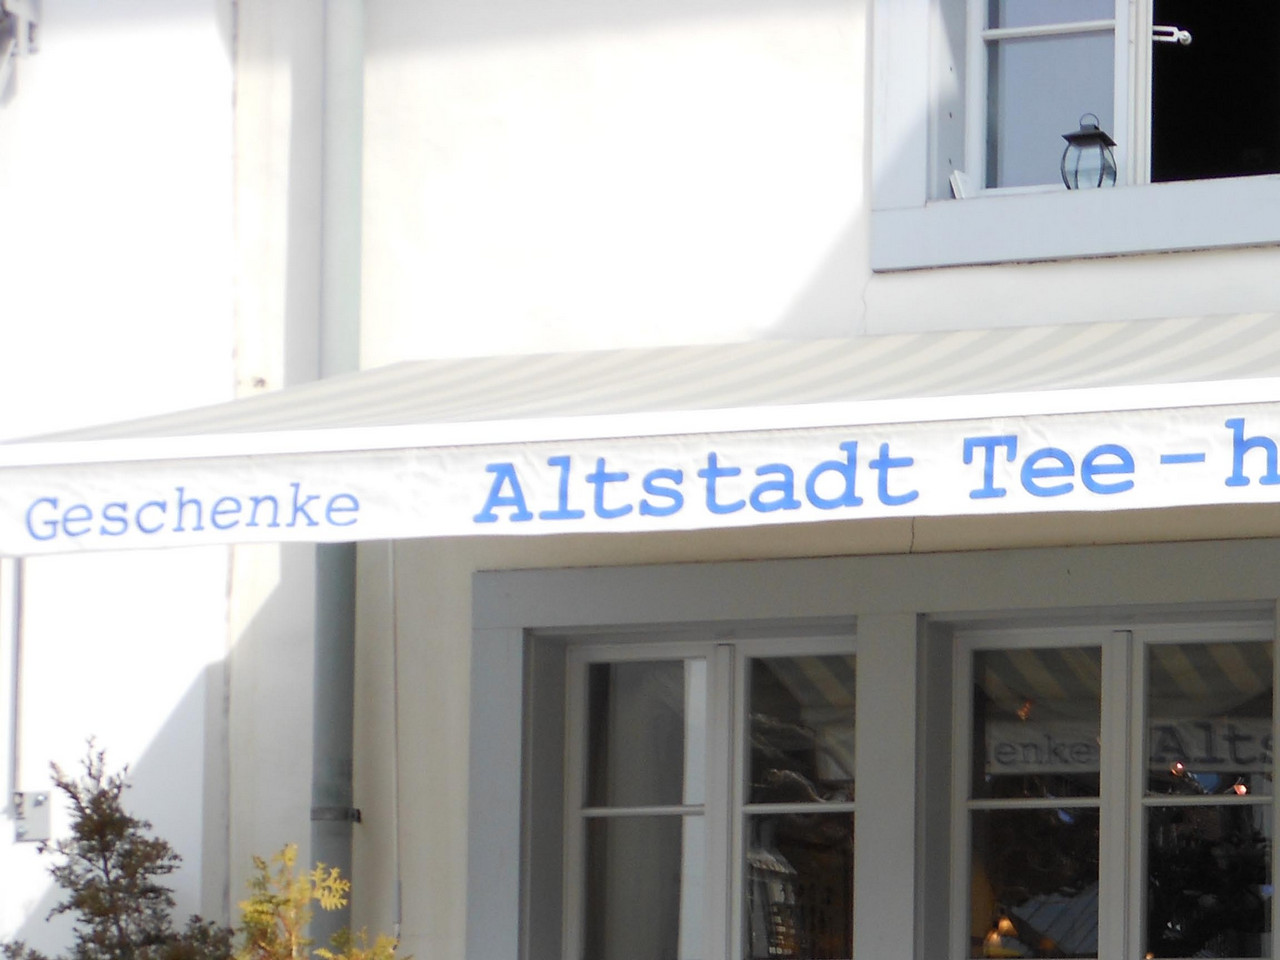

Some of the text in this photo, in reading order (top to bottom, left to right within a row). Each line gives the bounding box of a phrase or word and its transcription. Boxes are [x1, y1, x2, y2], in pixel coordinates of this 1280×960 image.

[26, 482, 360, 541] Geschenke
[473, 440, 919, 524] Altstadt
[988, 733, 1097, 765] enke
